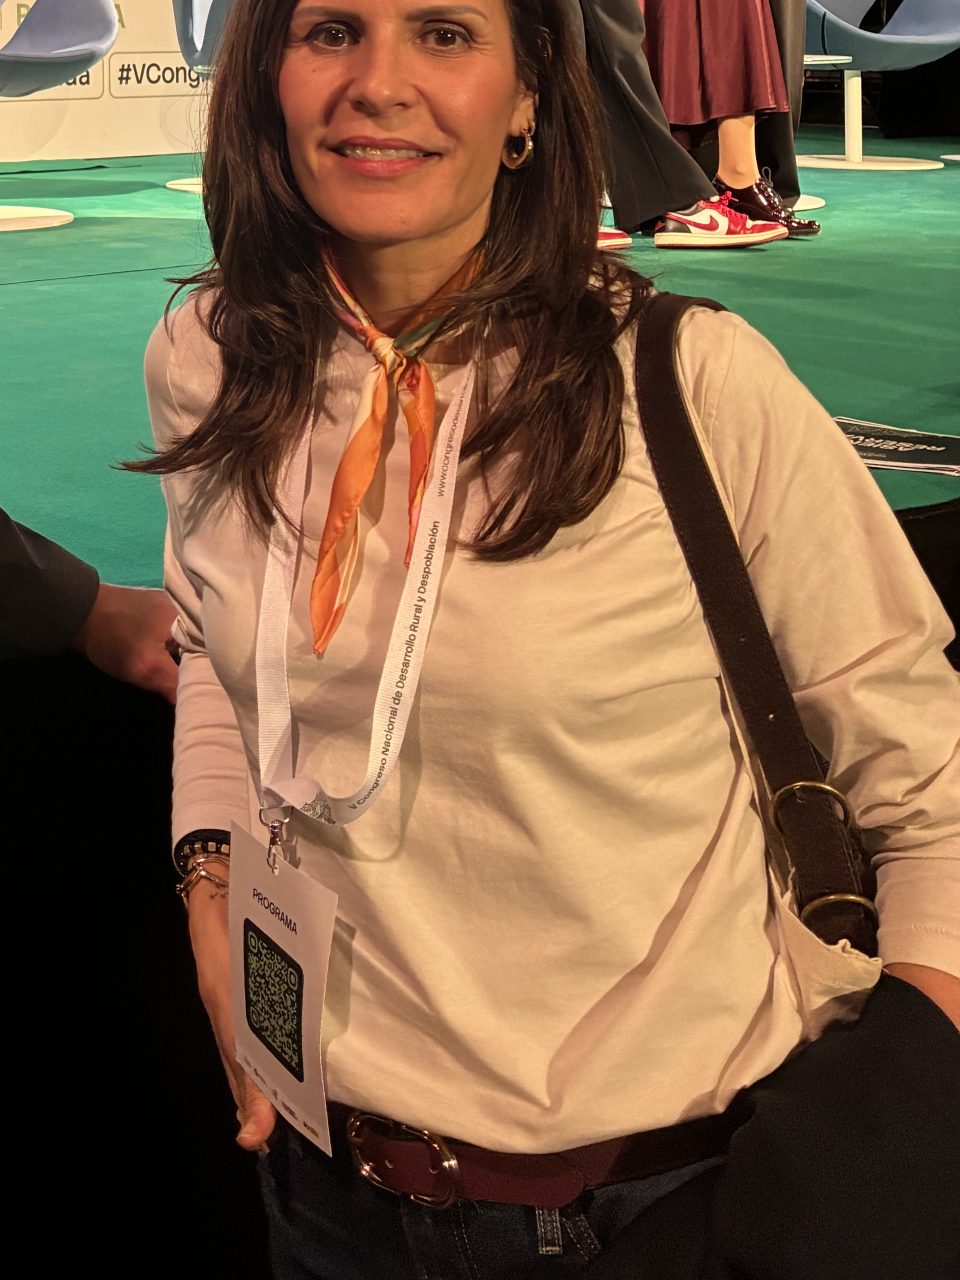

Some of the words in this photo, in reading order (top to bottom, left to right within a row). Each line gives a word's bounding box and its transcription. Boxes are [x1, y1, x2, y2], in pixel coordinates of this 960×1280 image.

[417, 520, 441, 595] Despoblación
[409, 603, 423, 633] Rural
[395, 633, 417, 690] Desarrollo
[392, 690, 403, 706] de
[381, 706, 399, 756] Nacional
[357, 757, 387, 806] Congreso
[252, 888, 298, 936] PROGRAMA
